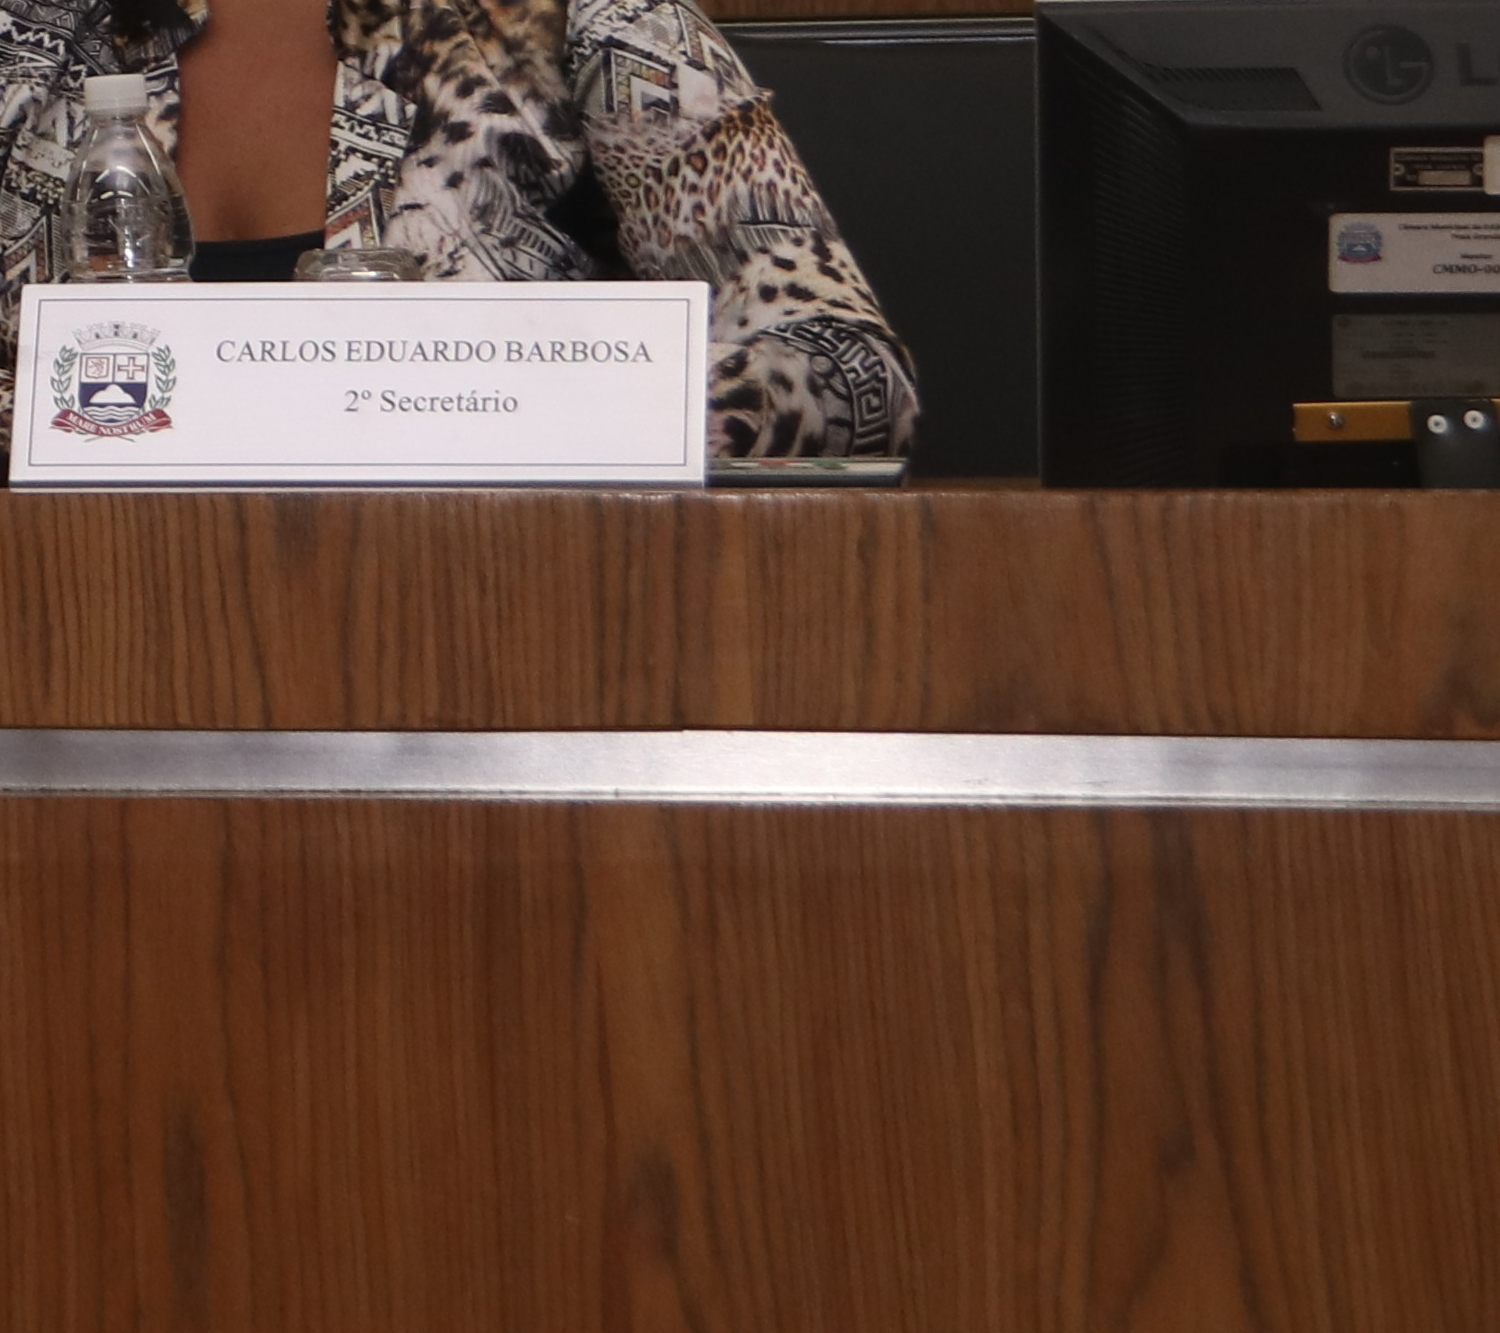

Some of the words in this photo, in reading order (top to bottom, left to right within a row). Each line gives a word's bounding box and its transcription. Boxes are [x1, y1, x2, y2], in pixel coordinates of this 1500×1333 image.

[215, 339, 337, 363] CARLOS
[344, 340, 497, 363] EDUARDO
[504, 340, 654, 363] BARBOSA
[343, 389, 373, 413] 2º
[379, 389, 519, 414] Secretário
[66, 412, 98, 432] MARE
